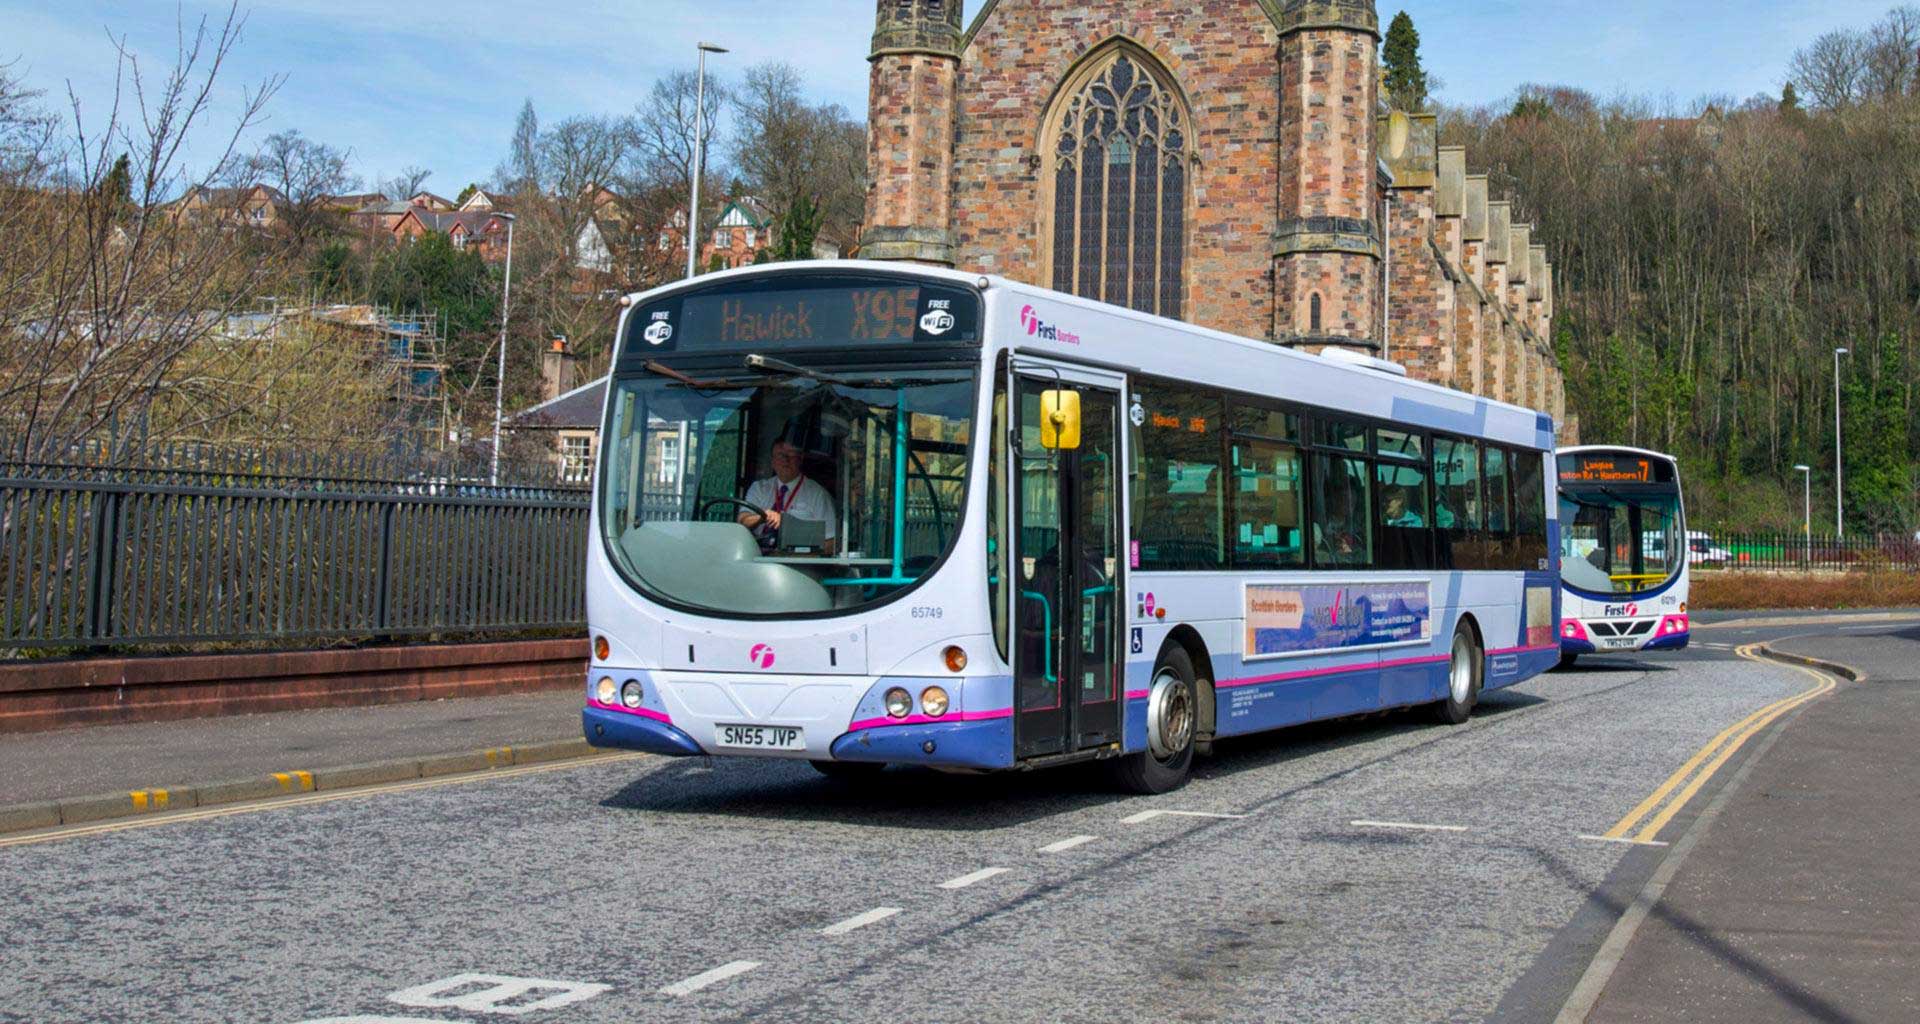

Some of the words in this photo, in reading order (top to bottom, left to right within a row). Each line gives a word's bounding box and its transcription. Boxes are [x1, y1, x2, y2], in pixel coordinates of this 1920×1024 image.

[851, 287, 920, 339] X95
[928, 299, 951, 309] FREE
[651, 311, 670, 320] FREE
[720, 300, 815, 341] Hawick
[1037, 320, 1057, 341] First
[1638, 460, 1649, 482] 7
[911, 606, 943, 619] 65749
[1251, 599, 1274, 614] Scottish
[1275, 599, 1298, 613] Borders
[1605, 604, 1626, 616] First
[724, 726, 764, 746] SN55
[767, 728, 797, 747] JVP
